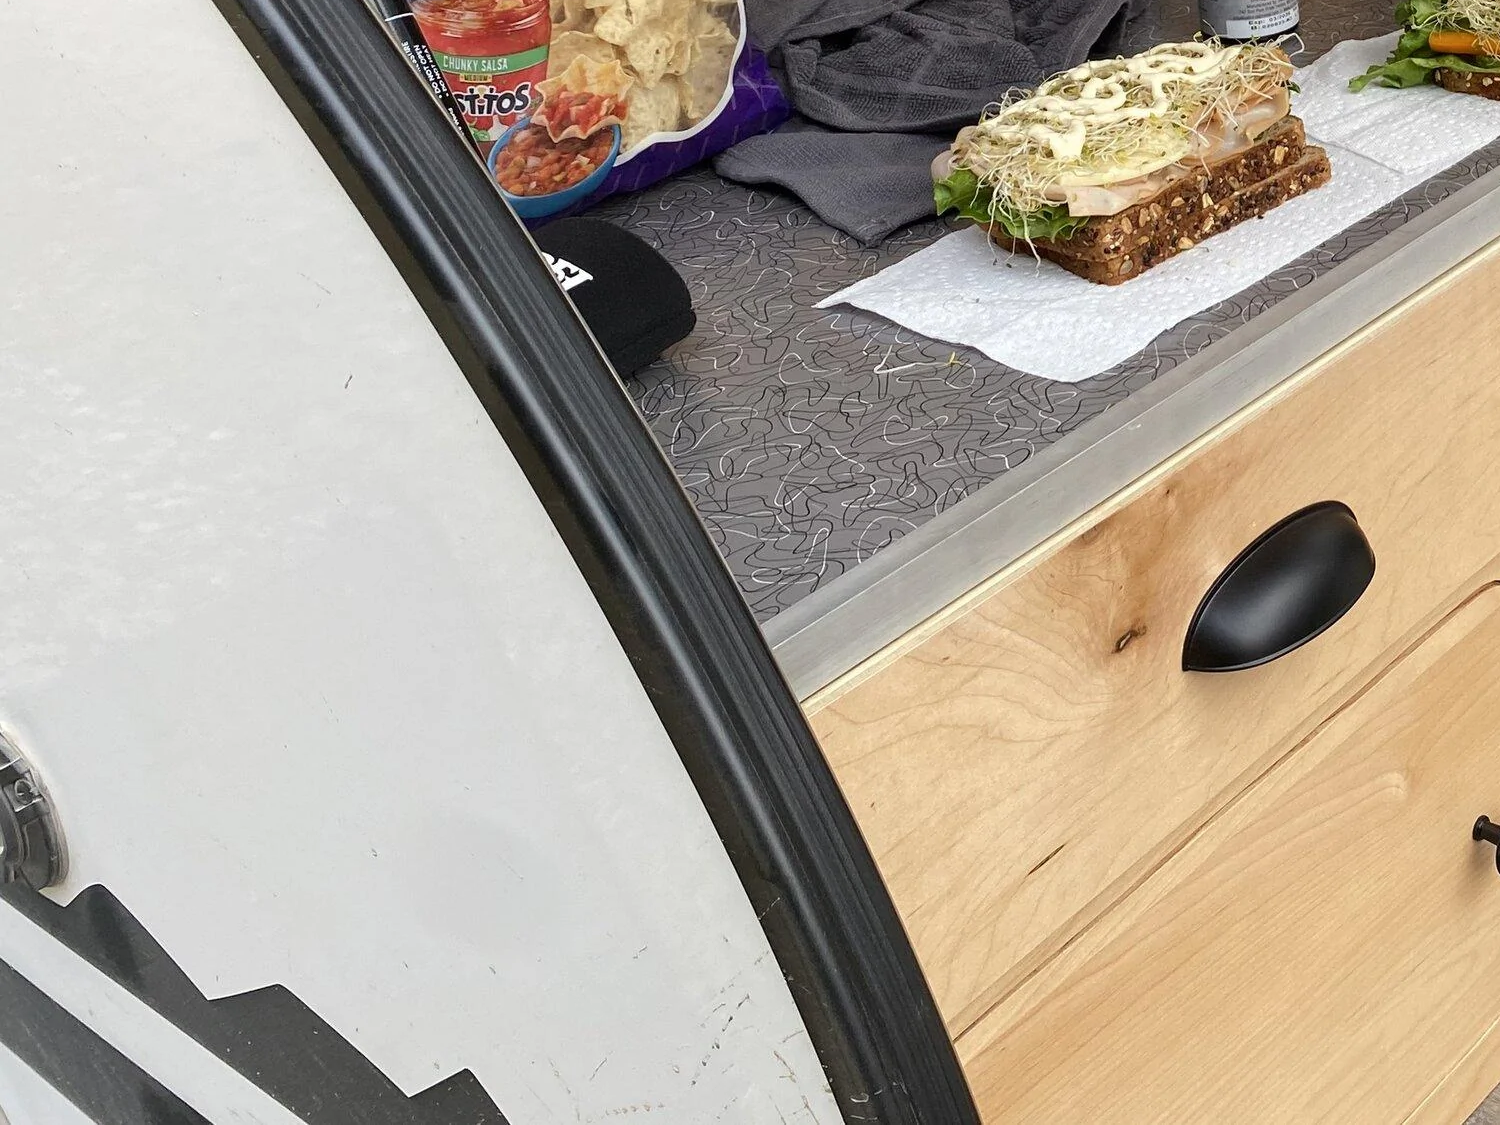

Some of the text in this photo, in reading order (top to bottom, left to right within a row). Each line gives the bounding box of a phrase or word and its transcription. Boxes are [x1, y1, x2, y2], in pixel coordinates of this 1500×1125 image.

[413, 44, 442, 95] DO NOT OPEN
[443, 55, 508, 72] CHUNKY SALSA
